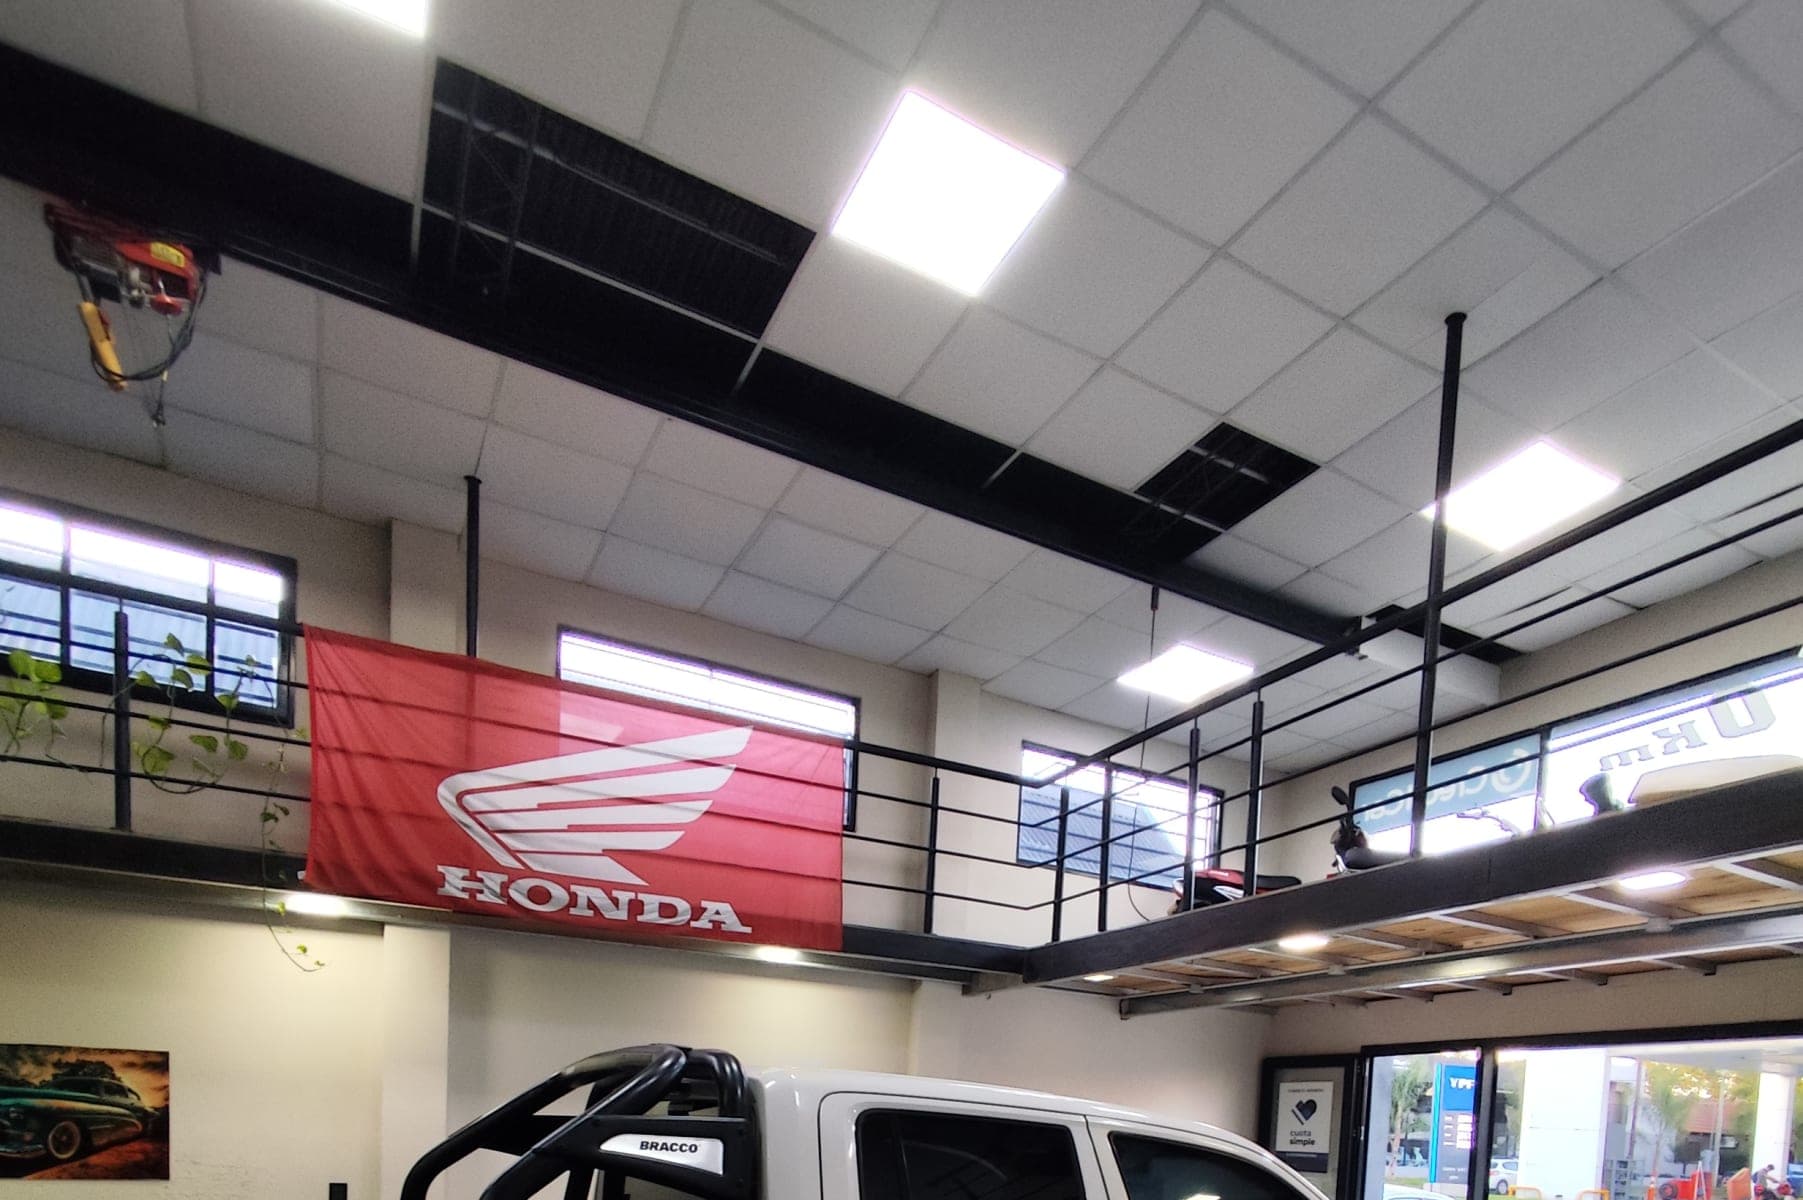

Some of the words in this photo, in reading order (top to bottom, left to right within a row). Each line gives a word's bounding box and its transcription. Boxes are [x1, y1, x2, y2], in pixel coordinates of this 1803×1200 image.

[436, 864, 752, 934] HONDA
[1449, 1077, 1476, 1090] YPF
[639, 1140, 699, 1154] BRACCO
[1289, 1137, 1316, 1146] simple
